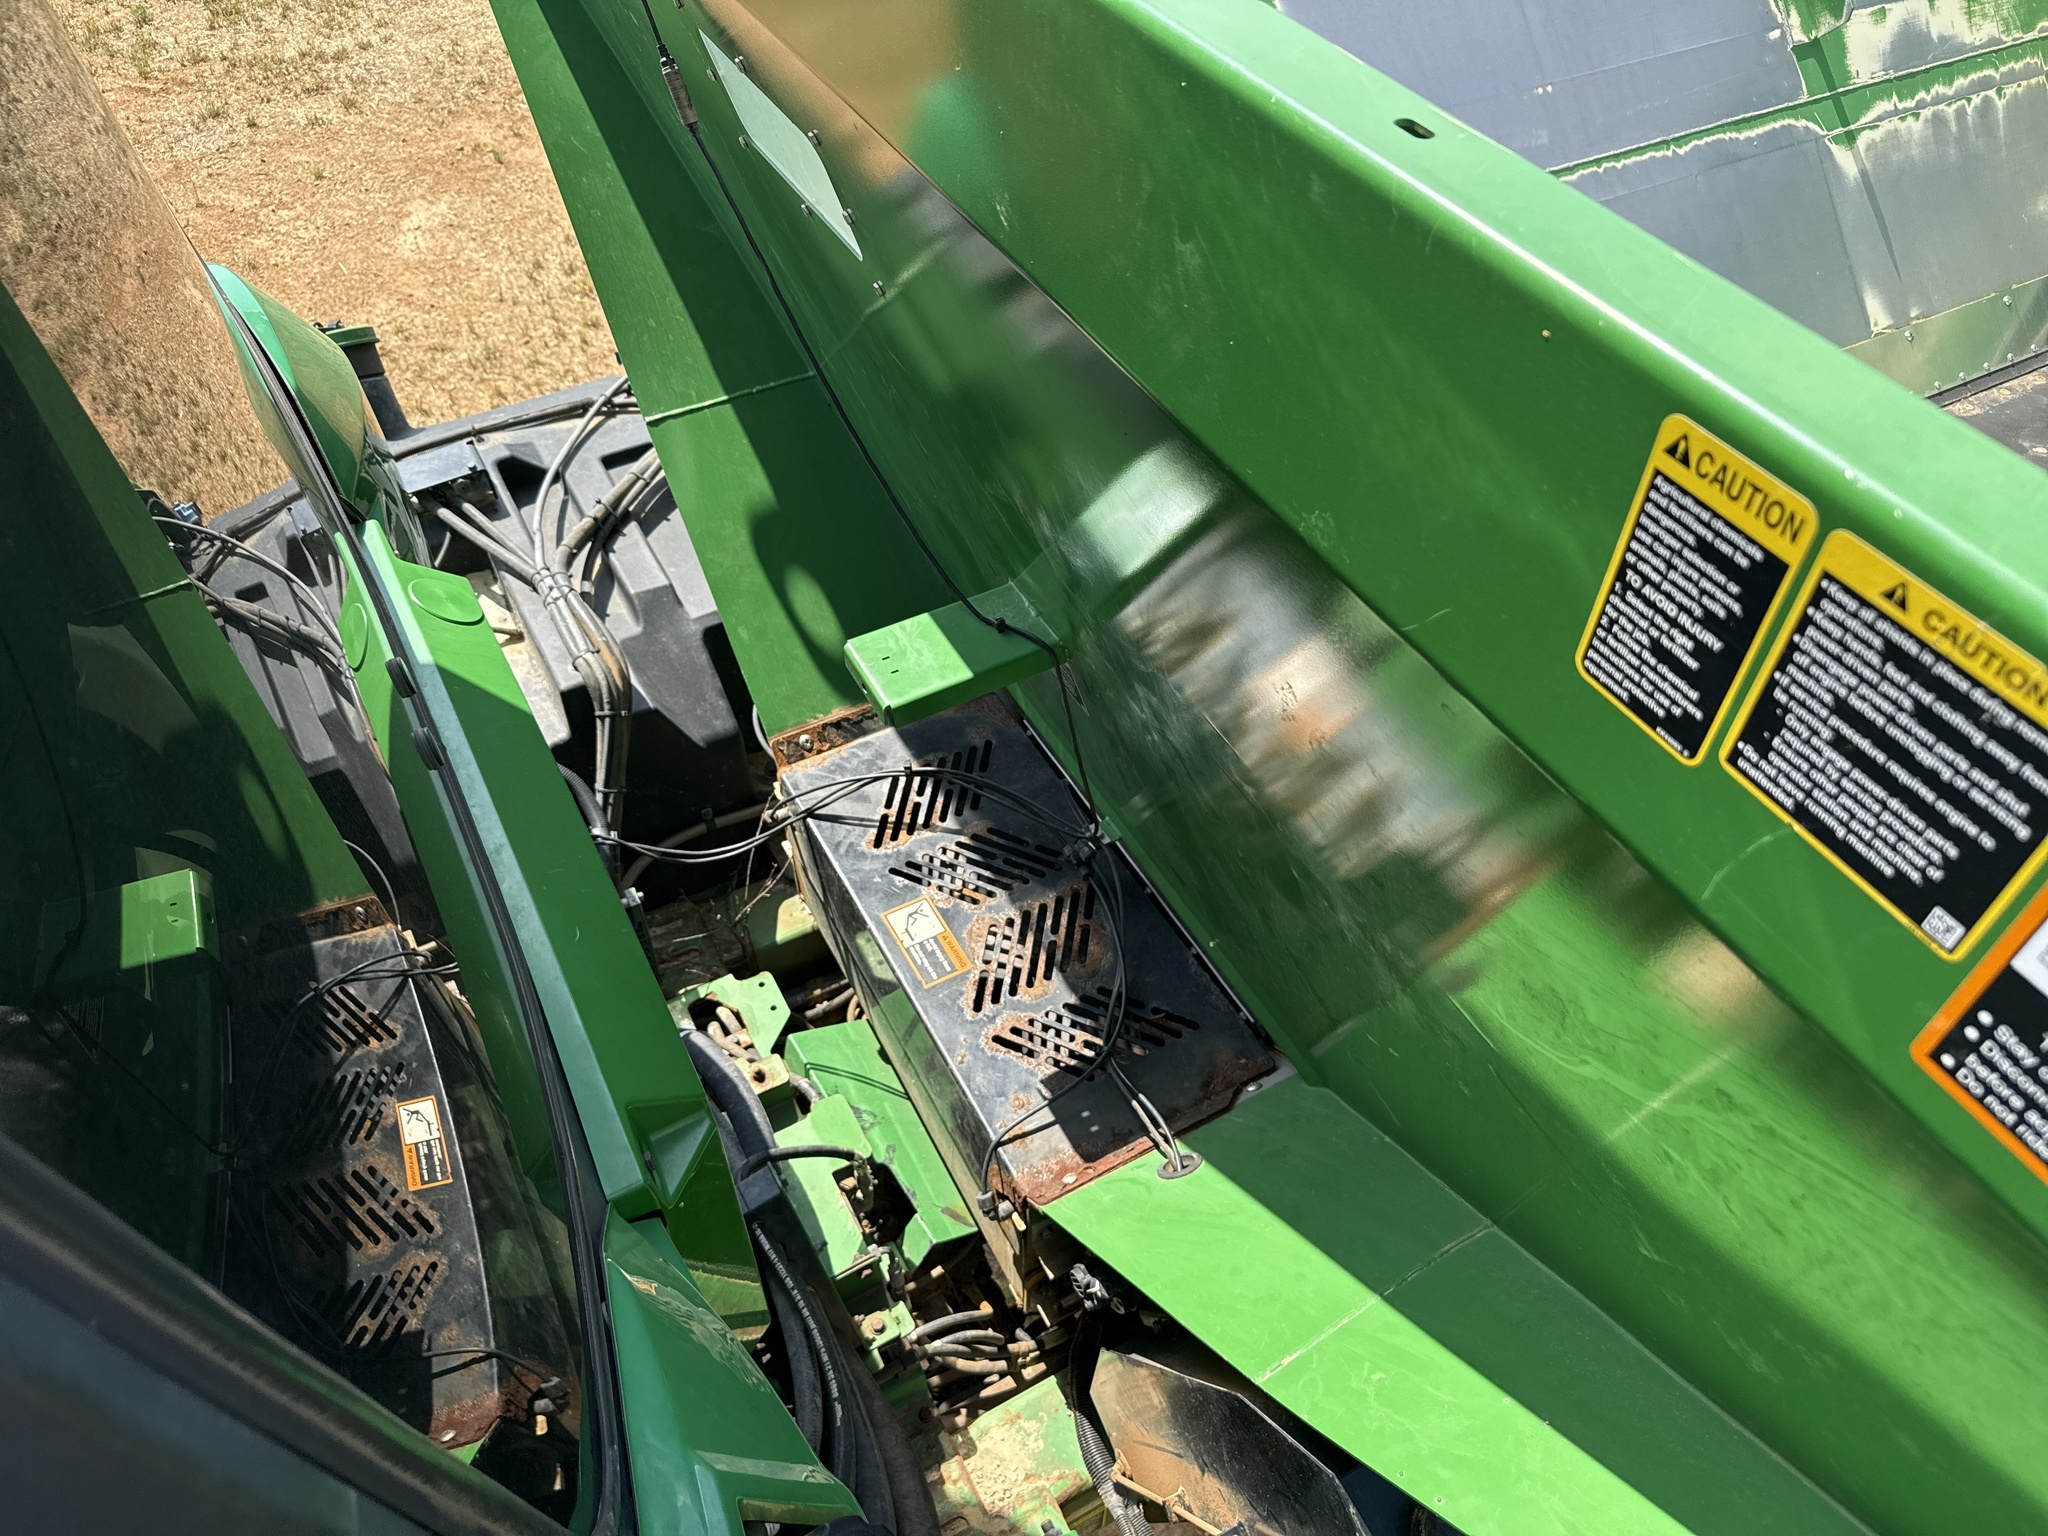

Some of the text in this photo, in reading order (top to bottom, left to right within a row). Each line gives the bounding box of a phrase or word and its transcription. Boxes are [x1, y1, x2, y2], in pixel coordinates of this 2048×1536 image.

[1644, 502, 1696, 546] dangerous.
[1648, 488, 1750, 567] and fertilizers can be
[1653, 475, 1763, 560] Agricultural chemicals
[1695, 451, 1803, 542] CAUTION
[1625, 551, 1703, 617] or other property.
[1629, 539, 1726, 618] animals, plants, soils
[1634, 527, 1741, 615] use can injure persons,
[1639, 513, 1740, 594] Improper selection or
[1604, 603, 1650, 647] for the job.
[1608, 594, 1699, 669] chemical or fertilizer
[1614, 581, 1694, 651] 1. Select the right
[1625, 568, 1723, 651] TO AVOID INJURY
[1819, 598, 1883, 650] operations.
[1583, 659, 1628, 701] equipment.
[1587, 648, 1665, 717] personal protective
[1592, 636, 1683, 716] instructions for use of
[1595, 627, 1702, 720] or fertilizer manufacturers
[1599, 614, 1699, 701] 2. Follow the chemical
[1785, 663, 1834, 706] machine.
[1804, 625, 1914, 711] power-driven parts.
[1808, 610, 1844, 646] Keep
[1838, 632, 1882, 676] hands,
[1878, 661, 1909, 693] feet
[1902, 681, 1935, 705] and
[1931, 700, 1986, 746] clothing
[1982, 737, 2021, 772] away
[1826, 582, 1859, 616] Keep
[1854, 606, 1877, 627] all
[1873, 618, 1920, 656] shields
[1918, 649, 1935, 666] in
[1931, 661, 1971, 692] place
[1968, 687, 2015, 727] during
[1923, 610, 2048, 706] CAUTION
[1772, 686, 1834, 740] be running:
[1788, 651, 2031, 840] off engine before unclogging or servicing
[1798, 637, 2029, 816] Disengage power-driven parts and shut
[1737, 757, 1794, 809] unattended.
[1775, 674, 1995, 850] If service procedure requires engine to
[1777, 727, 1943, 864] required by service procedure.
[1784, 713, 1959, 859] Only engage power-driven parts
[1740, 744, 1897, 876] Do not leave running machine
[1767, 751, 1922, 883] operator station and machine.
[1771, 736, 1944, 881] Ensure other people are clear of
[946, 939, 966, 967] WARNING
[1964, 1053, 2024, 1110] before
[1993, 1024, 2039, 1067] Stay
[1955, 1066, 1984, 1097] Do
[1983, 1094, 2017, 1126] not
